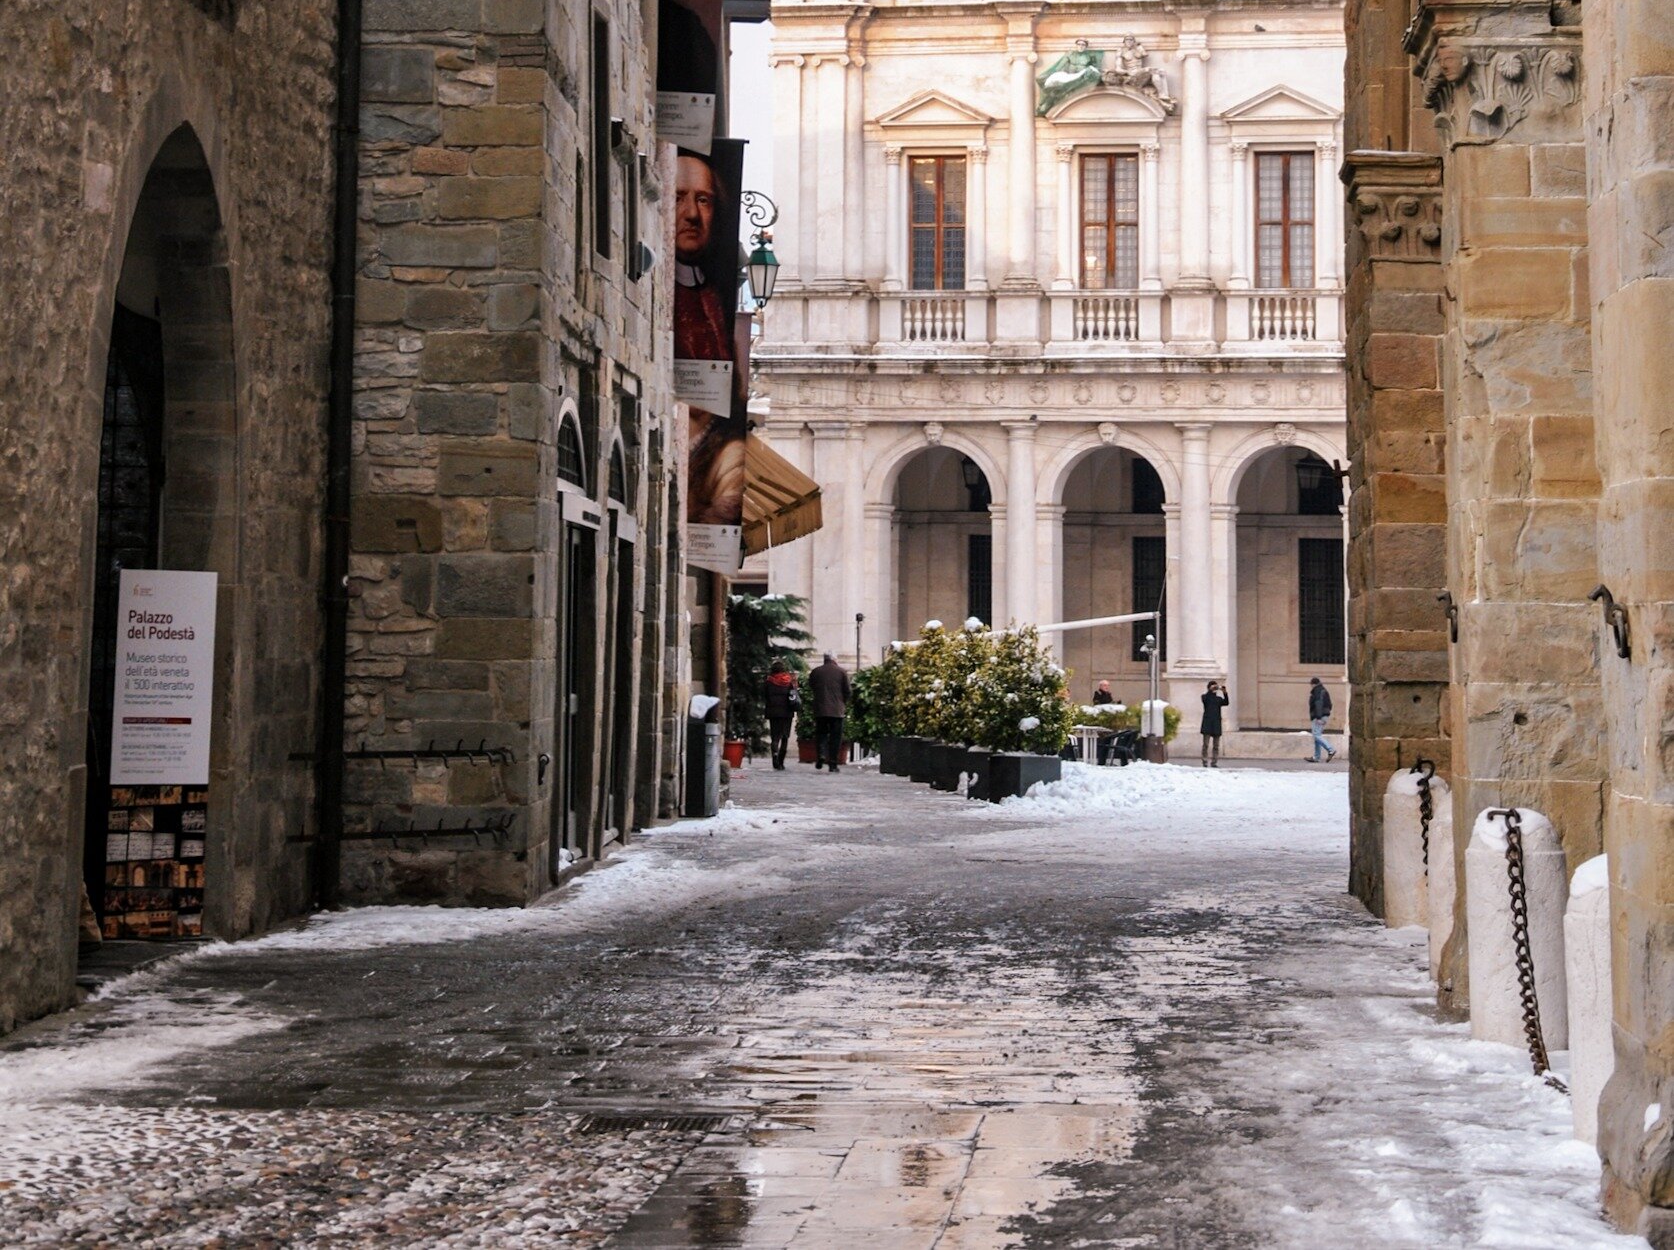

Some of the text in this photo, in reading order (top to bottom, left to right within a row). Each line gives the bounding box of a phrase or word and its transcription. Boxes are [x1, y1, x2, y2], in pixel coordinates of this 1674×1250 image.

[128, 610, 173, 625] Palazzo
[127, 626, 195, 640] del Podestà
[126, 652, 188, 664] Museo storico
[125, 666, 190, 677] dell'età veneta
[124, 679, 130, 690] il
[152, 680, 195, 691] interattivo
